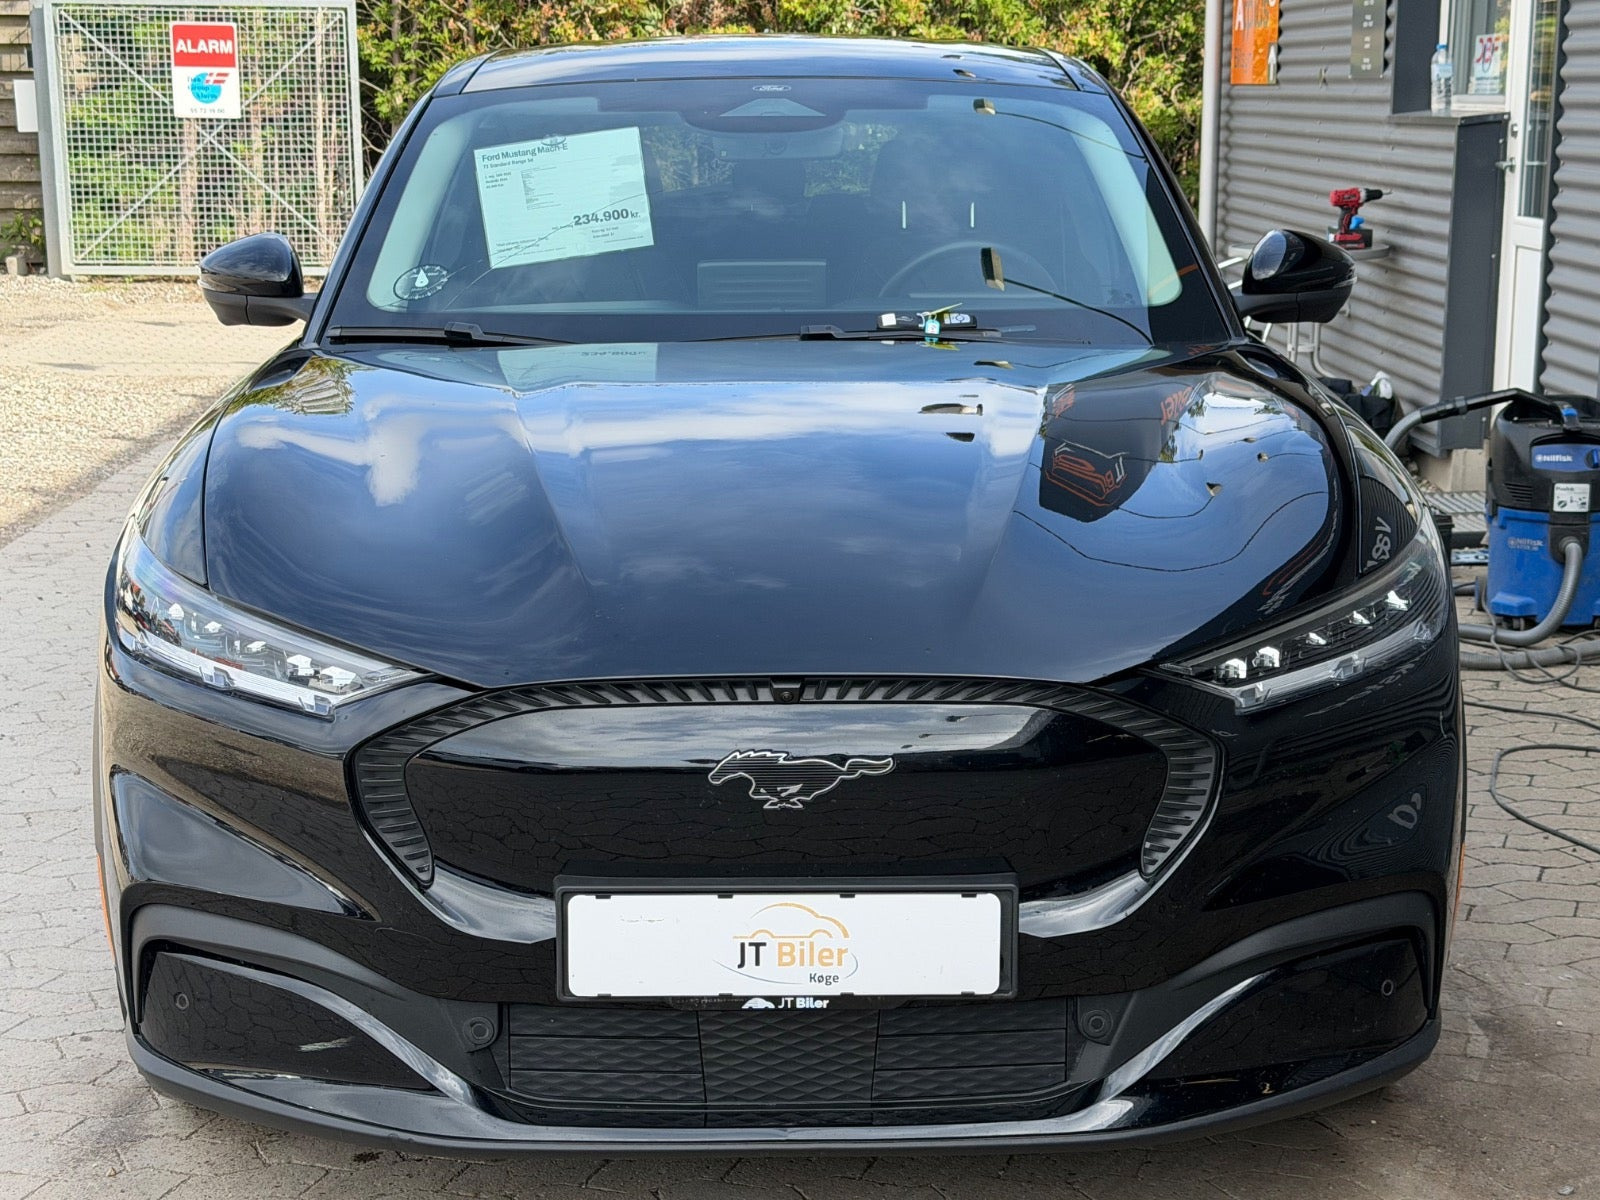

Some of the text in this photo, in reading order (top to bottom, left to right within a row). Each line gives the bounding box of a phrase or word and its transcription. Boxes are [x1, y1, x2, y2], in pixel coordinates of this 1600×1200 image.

[176, 38, 232, 54] ALARM
[482, 142, 569, 162] Ford Mustang Mach-E
[573, 208, 629, 226] 234.900
[1543, 454, 1573, 462] Nilfisk
[737, 941, 849, 969] JT Biler
[809, 972, 840, 986] Køge
[778, 997, 829, 1009] JT Biler
